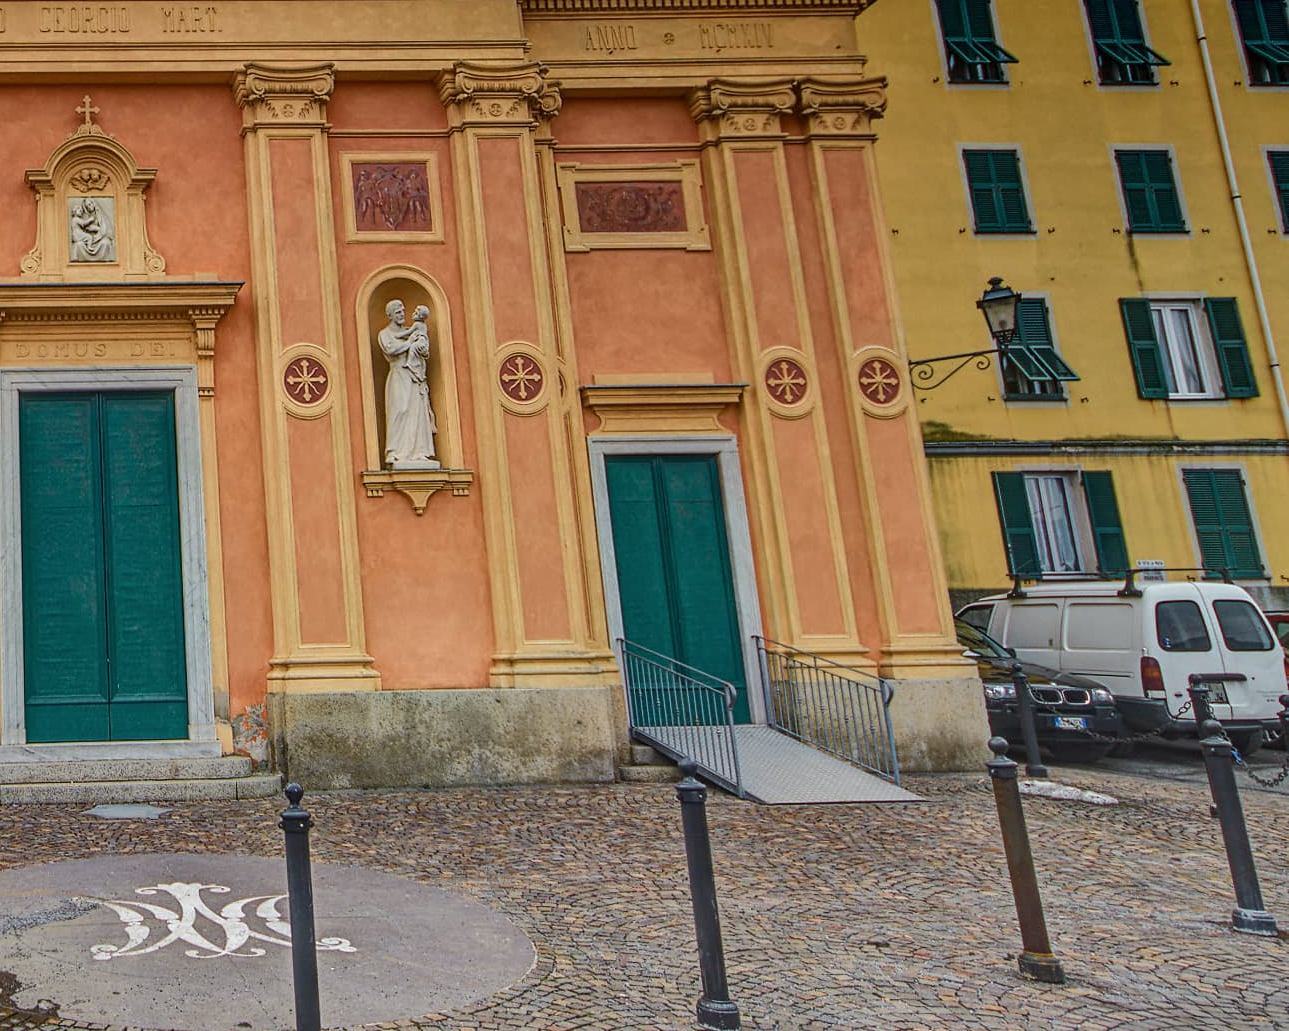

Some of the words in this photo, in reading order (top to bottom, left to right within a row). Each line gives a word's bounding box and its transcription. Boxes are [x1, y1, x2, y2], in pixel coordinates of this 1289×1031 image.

[584, 25, 639, 51] ANNO
[15, 342, 108, 359] DOMUS
[130, 341, 176, 358] DEI
